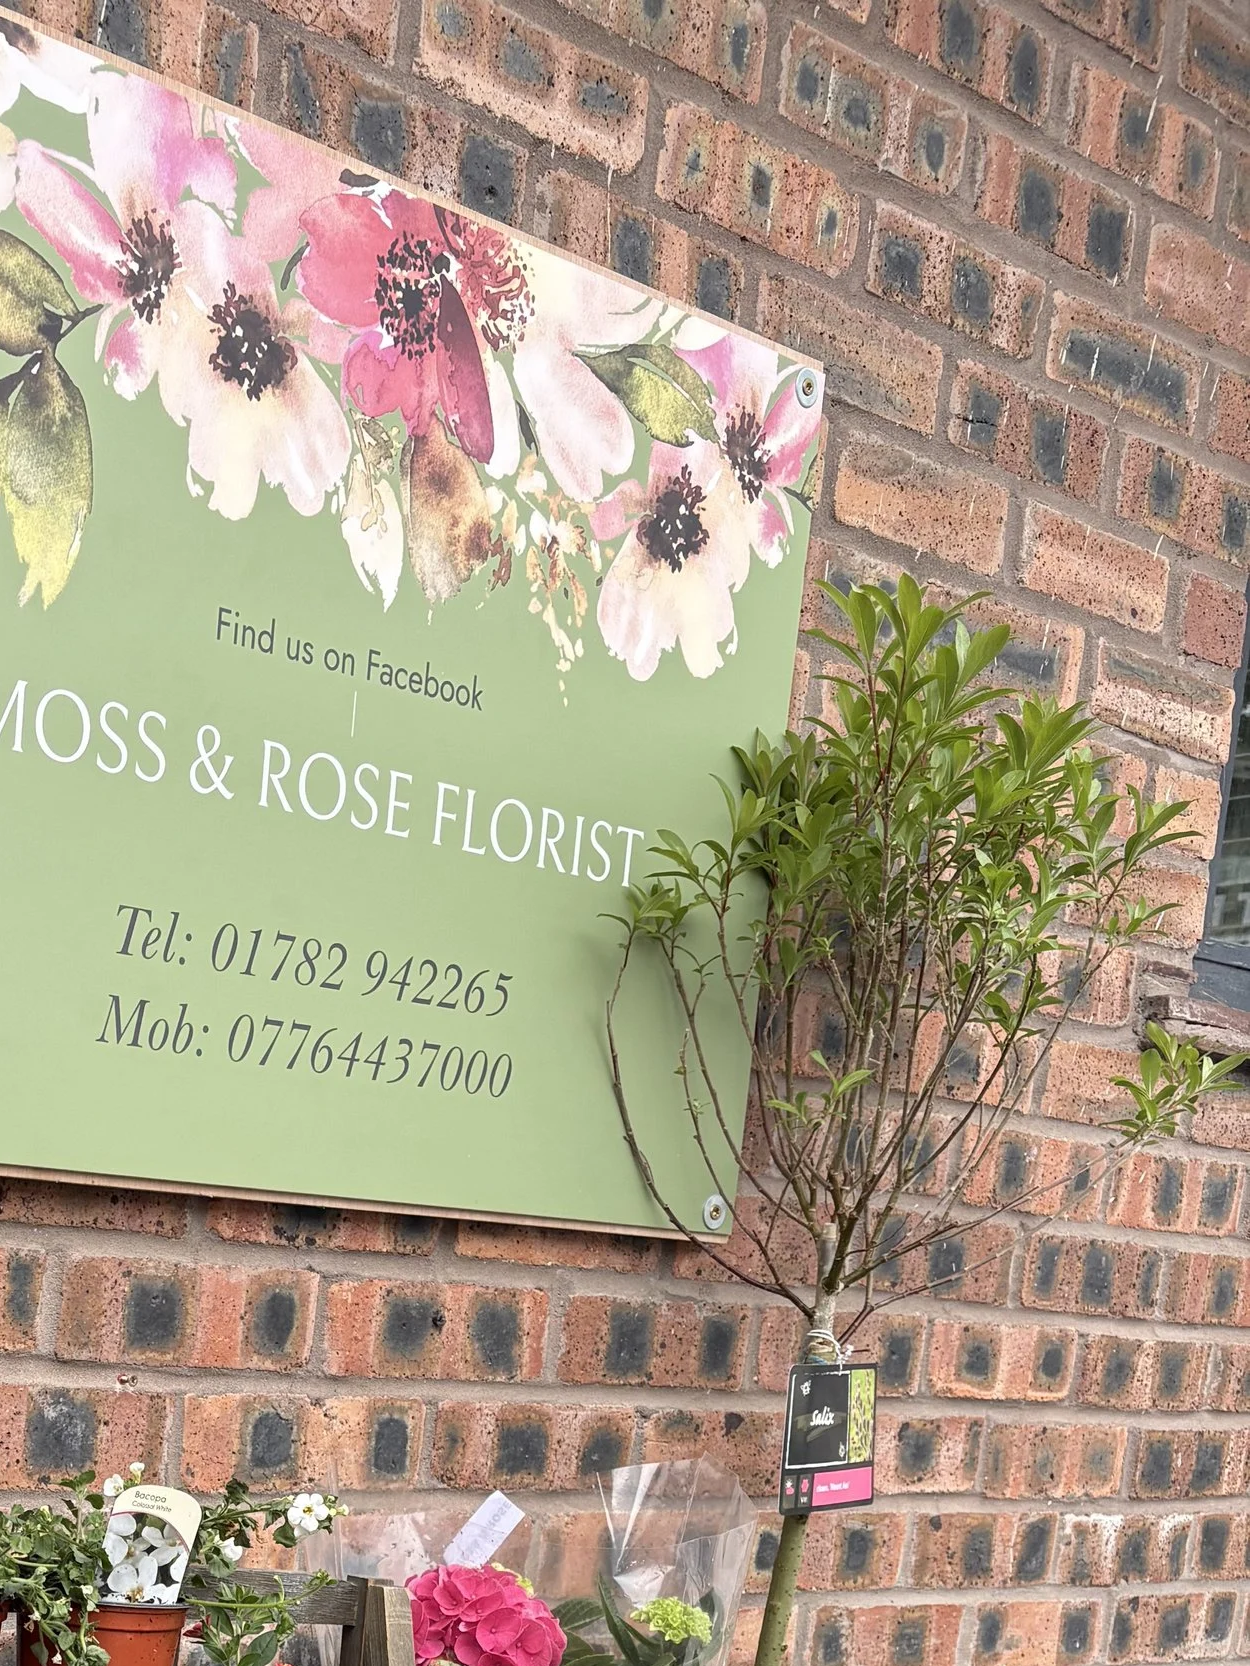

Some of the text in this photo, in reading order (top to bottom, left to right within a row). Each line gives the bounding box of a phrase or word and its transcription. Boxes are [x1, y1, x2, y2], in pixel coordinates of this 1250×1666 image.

[216, 606, 483, 711] Find us on Facebook
[189, 724, 235, 800] &
[258, 739, 413, 838] ROSE
[432, 781, 645, 887] FLORIST
[116, 904, 513, 1017] Tel: 01782 942265
[95, 994, 513, 1098] Mob: 07764437000
[132, 1500, 172, 1512] Colossal White
[134, 1490, 167, 1503] Bacopa
